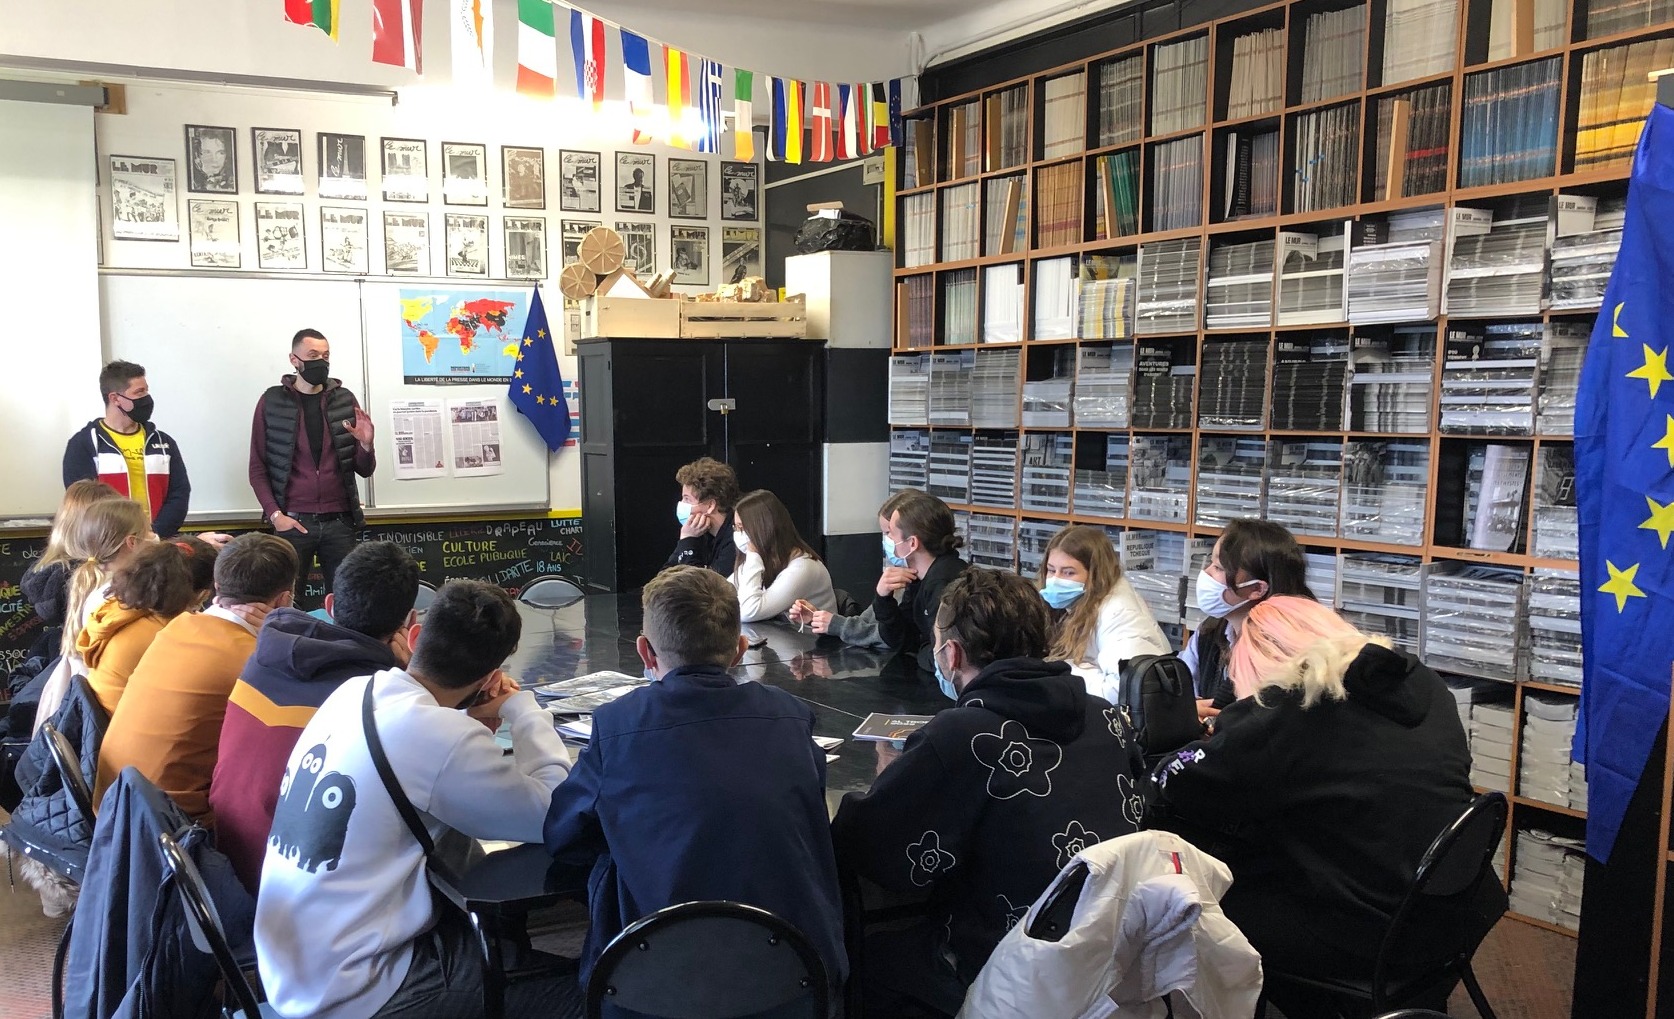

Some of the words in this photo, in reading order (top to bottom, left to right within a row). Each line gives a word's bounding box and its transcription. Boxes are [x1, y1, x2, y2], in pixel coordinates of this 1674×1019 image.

[486, 521, 543, 537] DRAPEAU
[550, 518, 583, 528] LUTTE
[442, 540, 498, 554] CULTURE
[443, 555, 476, 568] ECOLE
[536, 560, 545, 573] 18
[547, 563, 562, 573] ANS
